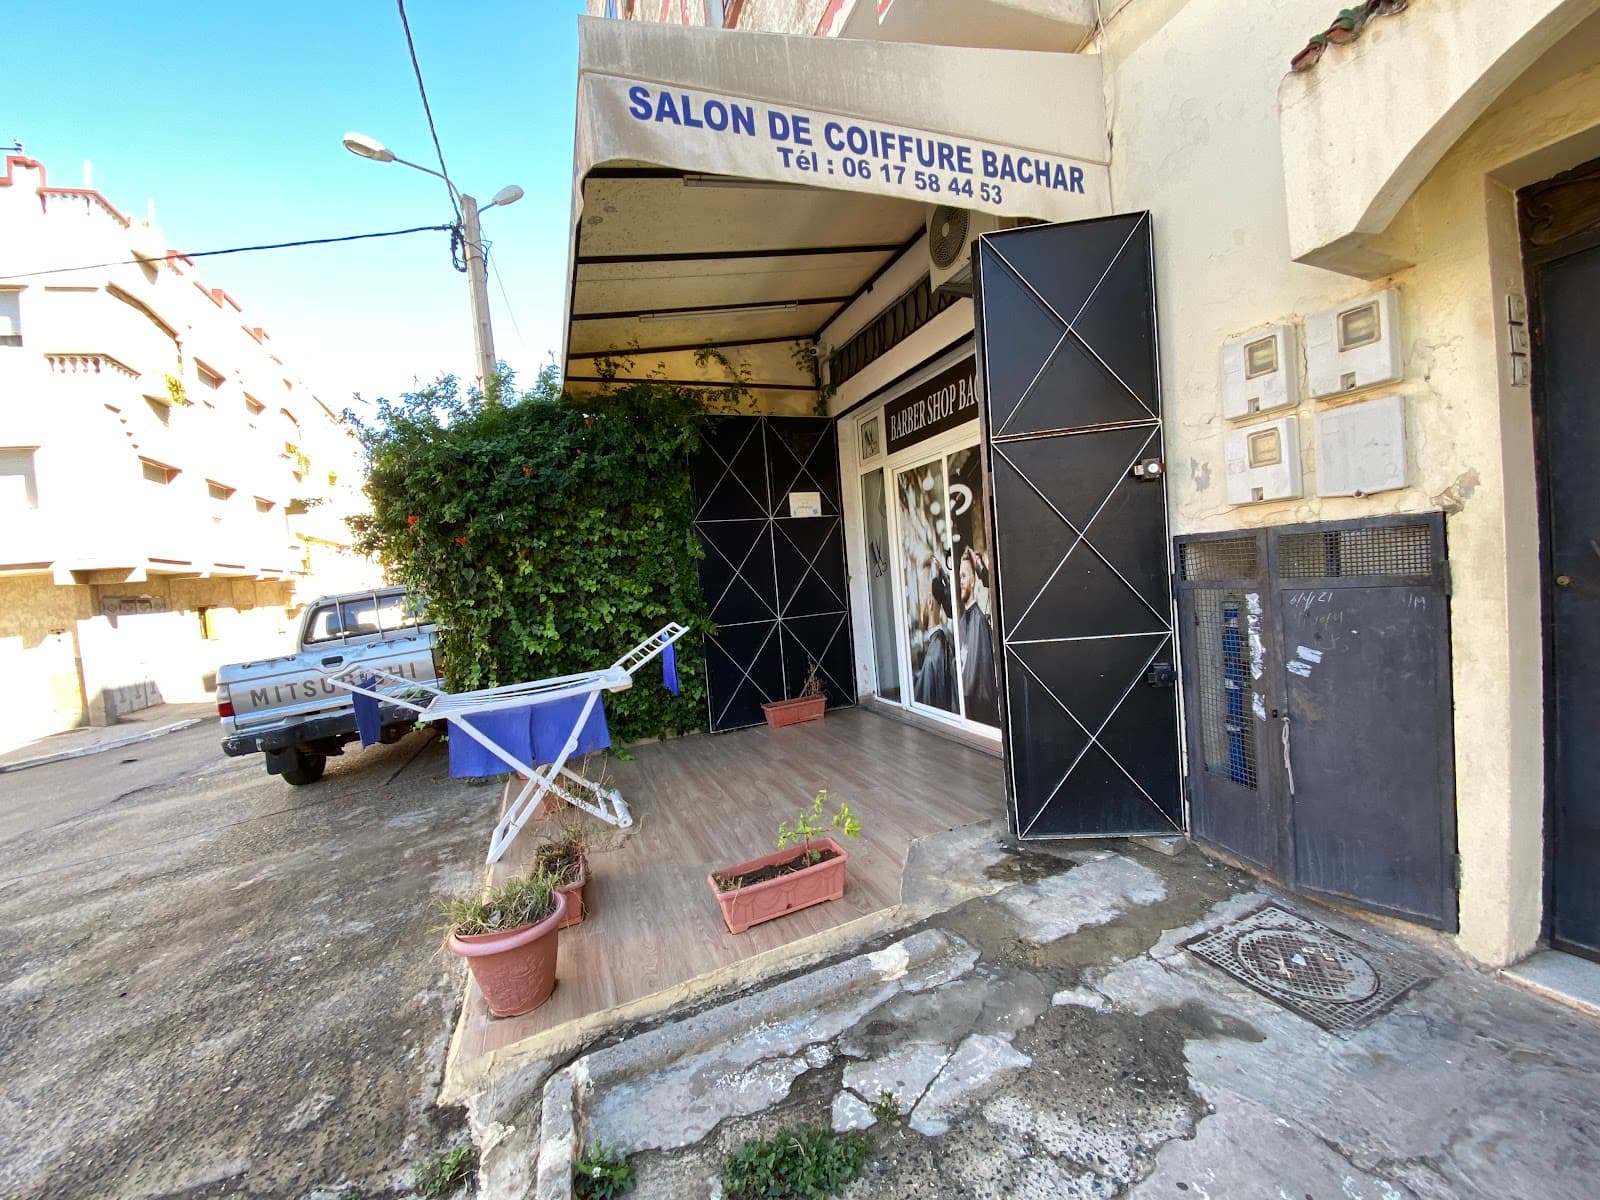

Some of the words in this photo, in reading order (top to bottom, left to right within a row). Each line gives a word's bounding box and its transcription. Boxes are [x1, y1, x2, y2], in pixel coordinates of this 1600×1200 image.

[628, 86, 756, 137] SALON
[767, 110, 813, 146] DE
[824, 121, 974, 174] COIFFURE
[982, 149, 1085, 194] BACHAR
[776, 146, 819, 173] Tél
[842, 157, 872, 179] 06
[880, 163, 906, 185] 17
[914, 170, 941, 192] 58
[948, 177, 974, 198] 44
[980, 182, 1003, 205] 53
[890, 399, 927, 442] BARBER
[927, 384, 957, 425] SHOP
